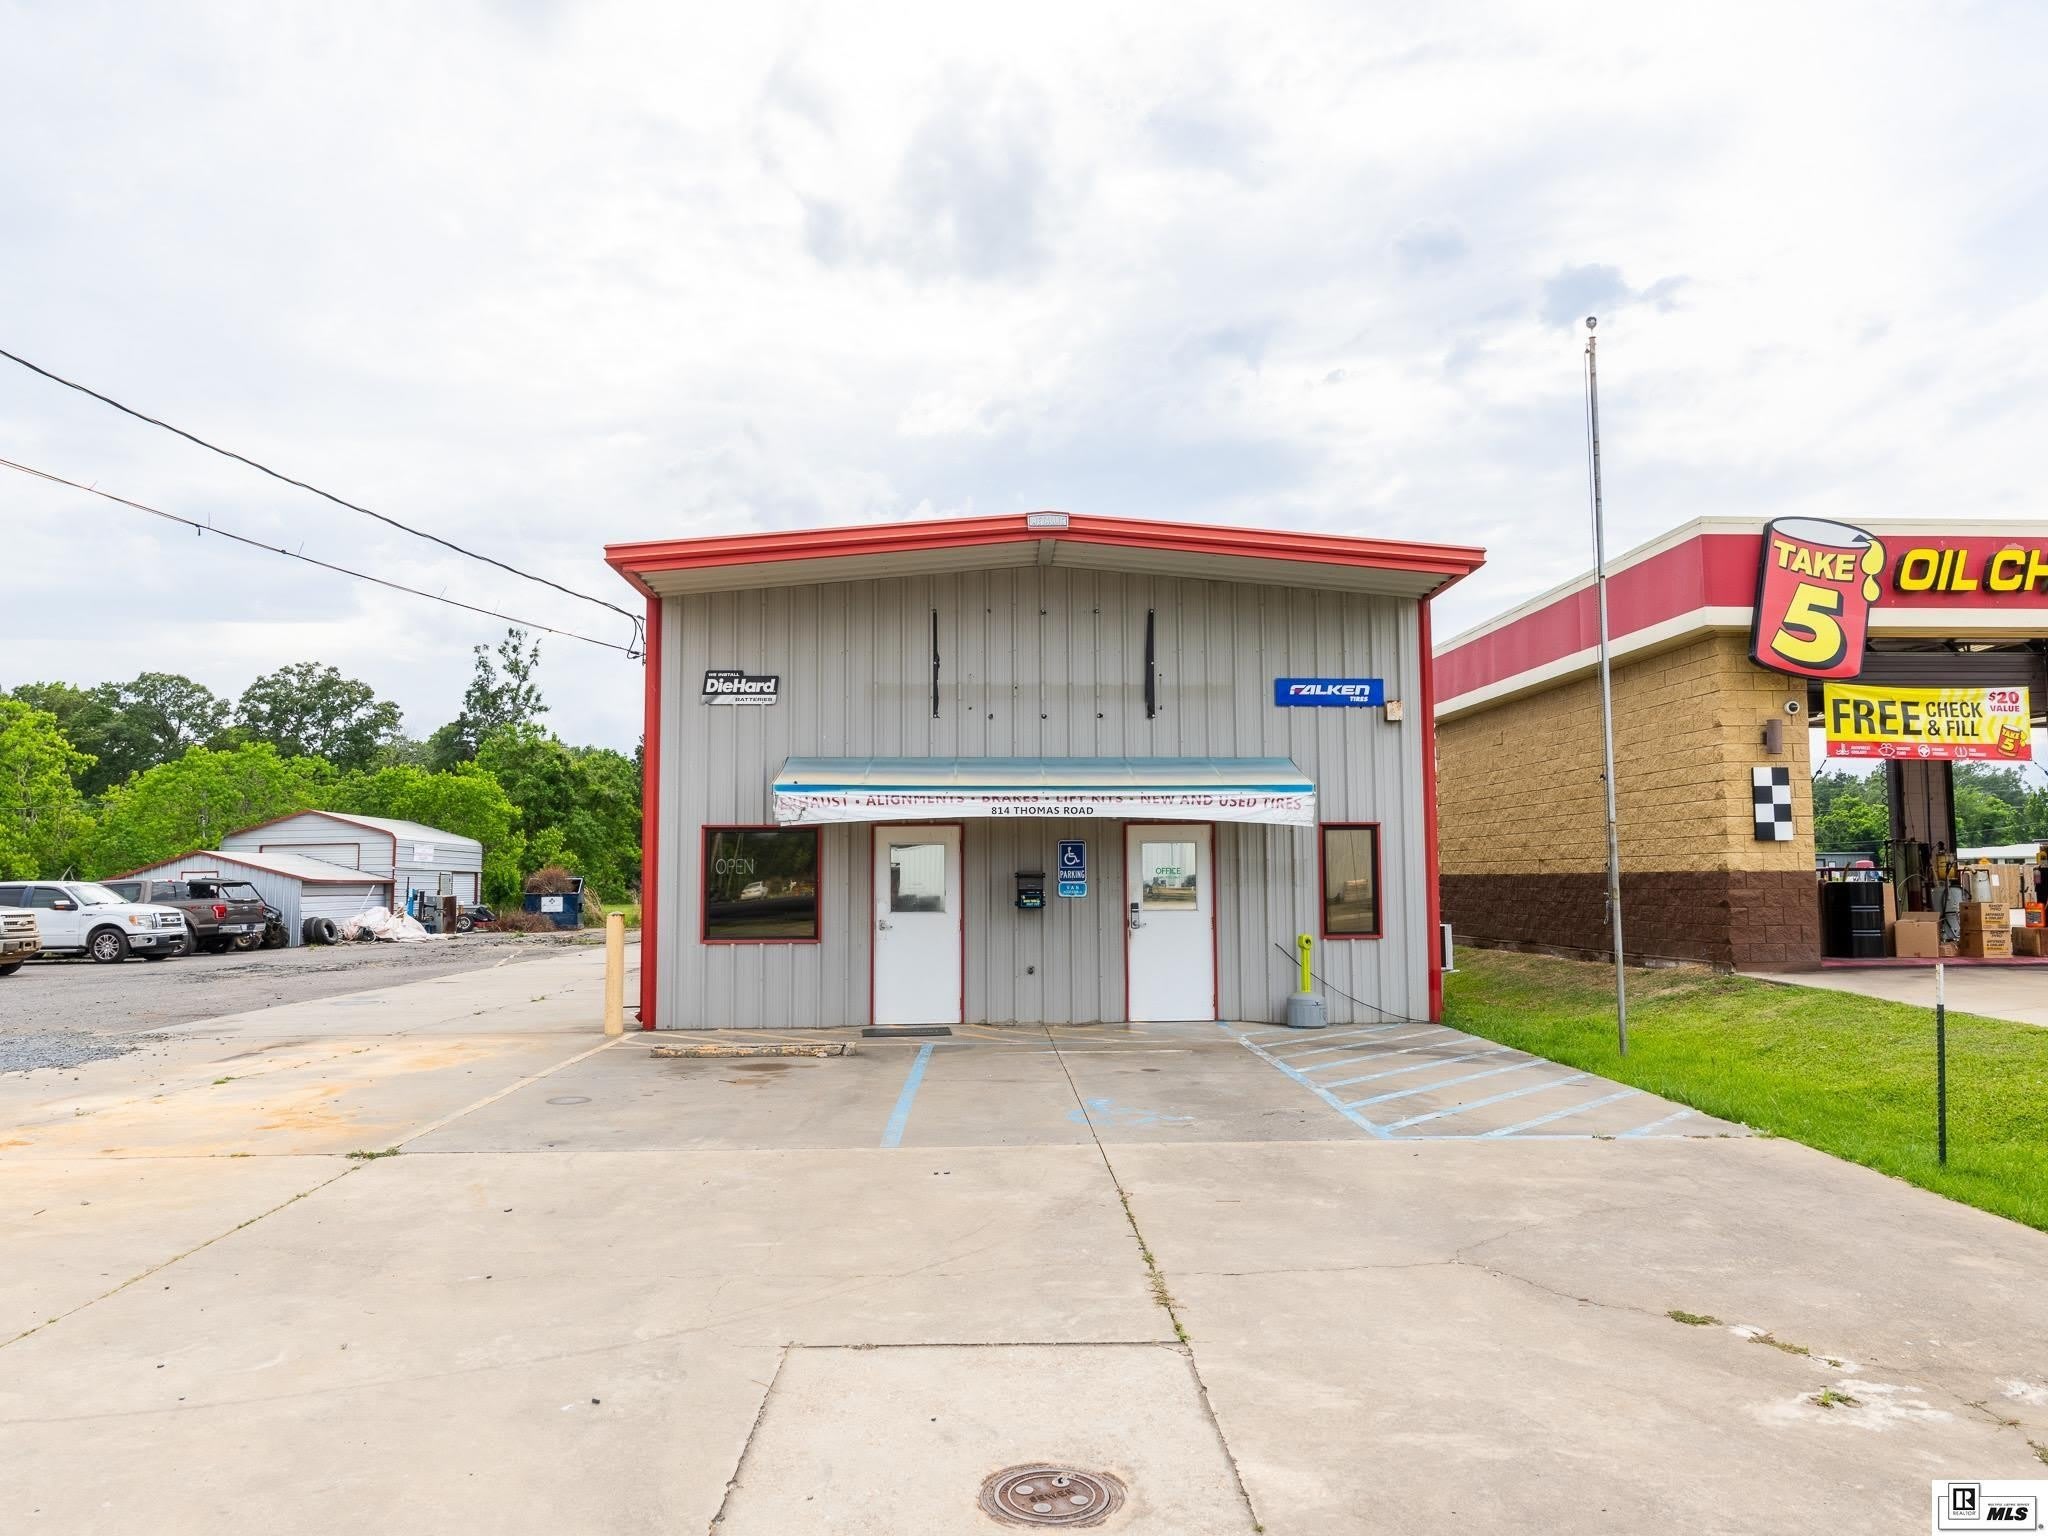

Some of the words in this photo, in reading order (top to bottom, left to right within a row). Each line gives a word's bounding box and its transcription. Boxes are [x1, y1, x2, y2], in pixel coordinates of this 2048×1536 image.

[1773, 539, 1856, 583] TAKE
[1899, 548, 1979, 592] OIL
[1770, 582, 1846, 668] 5
[705, 678, 776, 693] DieHard
[1289, 684, 1371, 696] FALKEN
[1988, 691, 2020, 706] $20
[1925, 701, 1983, 718] CHECK
[1990, 704, 2020, 713] VALUE
[1832, 698, 1922, 736] FREE
[1928, 719, 1941, 736] &
[1947, 720, 1979, 737] FILL
[2001, 738, 2015, 751] 5
[866, 794, 965, 806] ALIGNMENTS
[1179, 794, 1214, 806] AND
[1219, 795, 1257, 808] USED
[991, 806, 1010, 815] 814
[1013, 806, 1060, 815] THOMAS
[1063, 806, 1094, 815] ROAD
[715, 858, 754, 875] OPEN
[1155, 867, 1182, 875] OFFICE
[1060, 870, 1085, 879] PARKING
